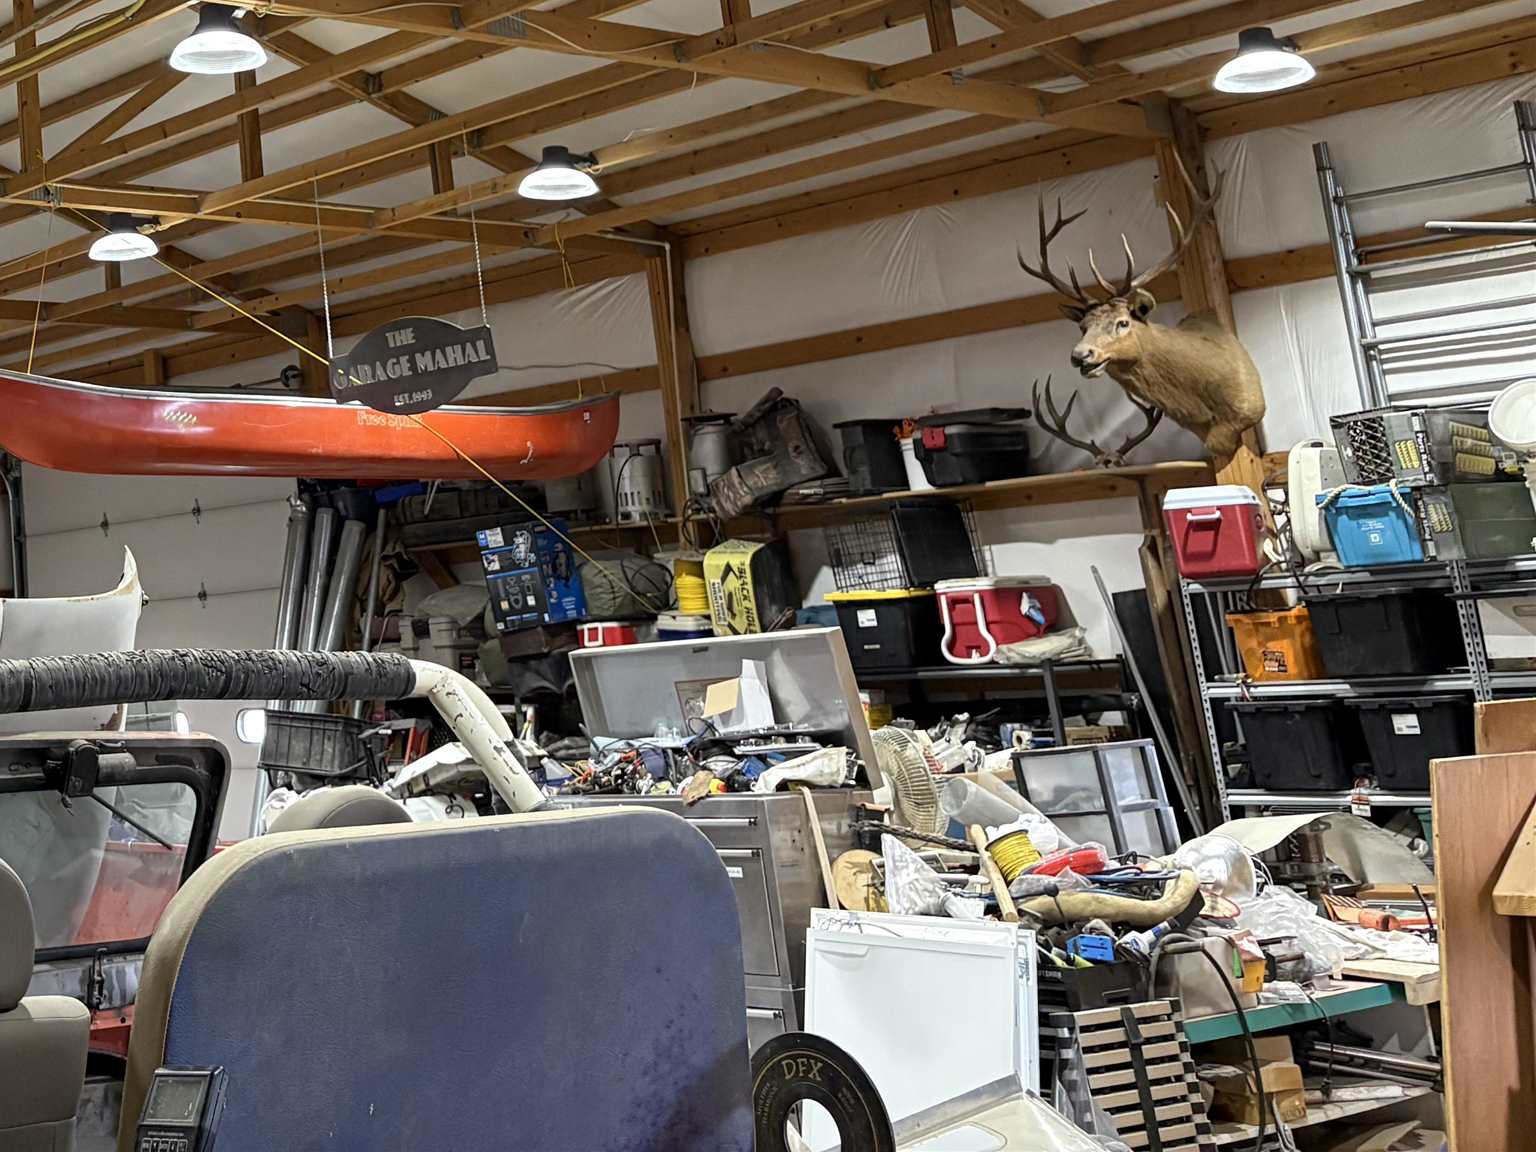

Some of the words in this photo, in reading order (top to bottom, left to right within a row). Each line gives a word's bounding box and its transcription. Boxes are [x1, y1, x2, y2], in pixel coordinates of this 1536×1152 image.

[385, 327, 416, 348] THE
[333, 355, 413, 390] GARAGE
[415, 339, 491, 374] MAHAL
[781, 1057, 824, 1082] DFX
